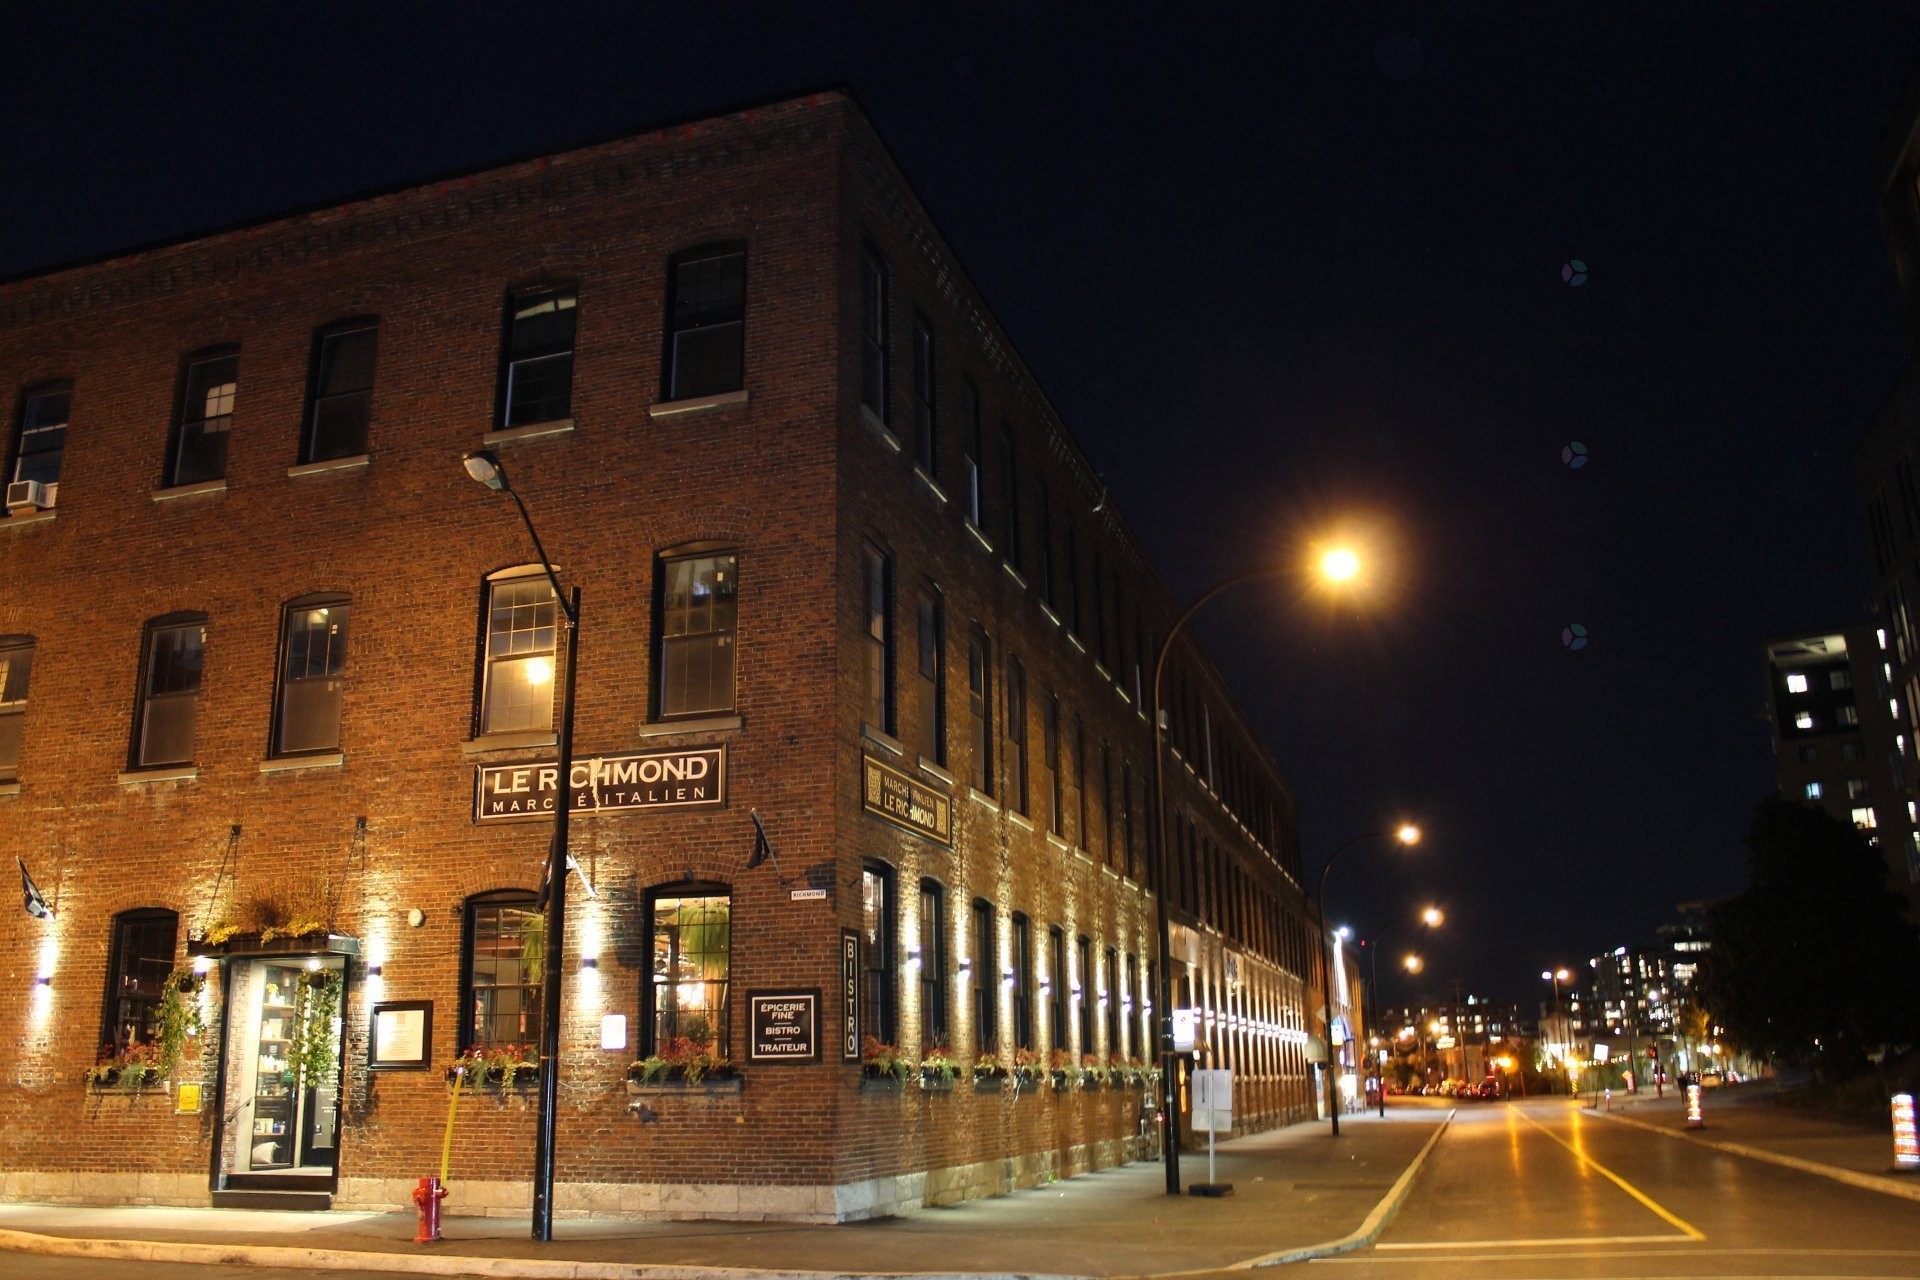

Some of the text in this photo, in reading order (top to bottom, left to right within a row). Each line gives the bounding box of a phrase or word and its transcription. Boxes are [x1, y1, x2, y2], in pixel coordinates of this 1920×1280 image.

[494, 757, 708, 794] LE RCHMOND
[493, 787, 705, 813] MARCÉ ITALIEN
[884, 793, 894, 811] LE
[761, 1003, 805, 1012] ÉPICERIE
[771, 1011, 794, 1020] FINE
[765, 1026, 800, 1035] BISTRO
[759, 1043, 806, 1052] TRAITEUR
